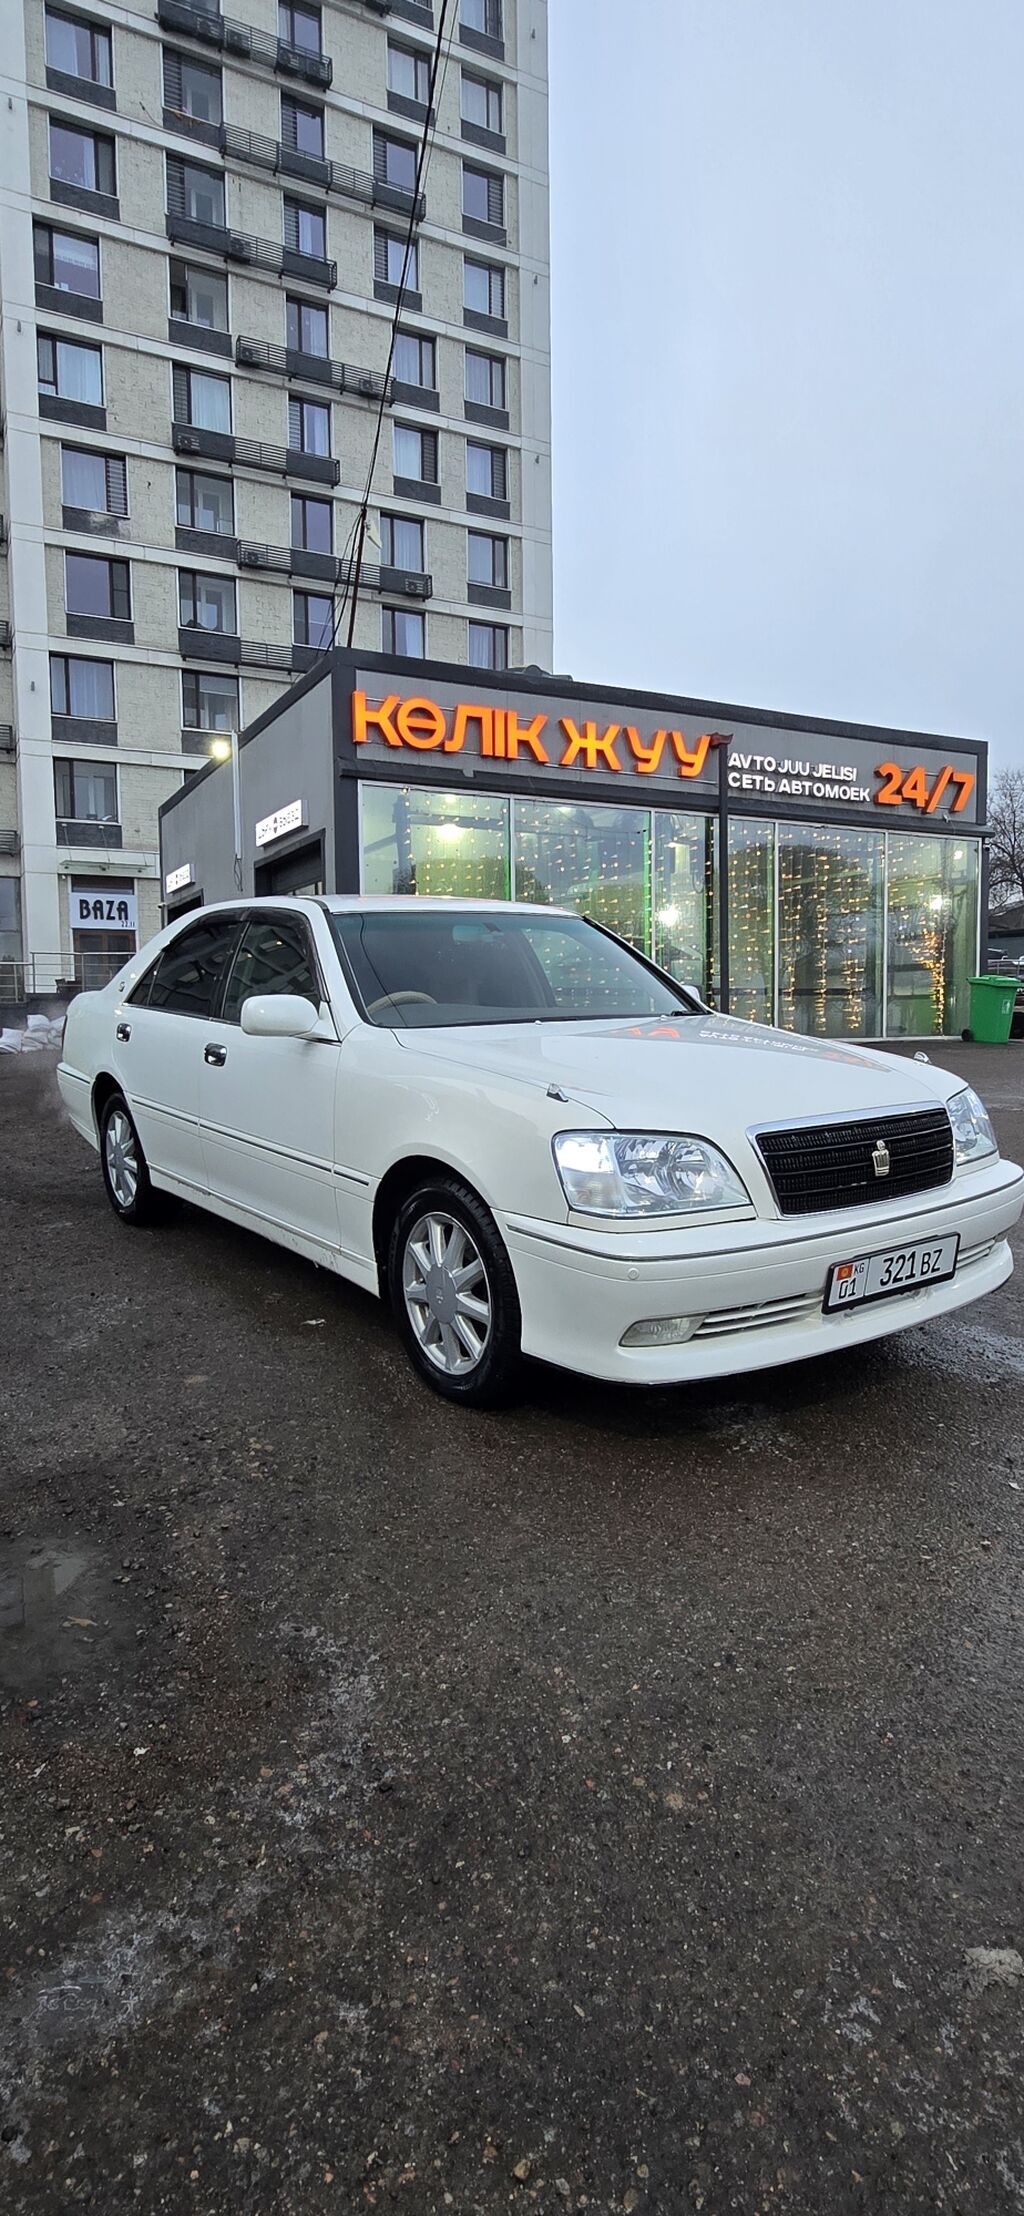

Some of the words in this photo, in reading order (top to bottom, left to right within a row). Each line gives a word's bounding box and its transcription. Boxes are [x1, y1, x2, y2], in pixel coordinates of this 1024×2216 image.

[352, 690, 549, 764] КӨЛІК
[559, 717, 712, 779] ЖУУ
[727, 752, 776, 772] AVTO
[778, 758, 810, 777] JUU
[812, 762, 858, 782] JELISI
[727, 772, 776, 793] СЕТЬ
[778, 778, 871, 803] АВТОМОЕК
[874, 761, 975, 815] 24/7
[79, 899, 129, 921] BAZA
[854, 1262, 865, 1275] KG
[880, 1250, 916, 1287] 321
[920, 1248, 943, 1276] BZ
[838, 1277, 857, 1300] 01
